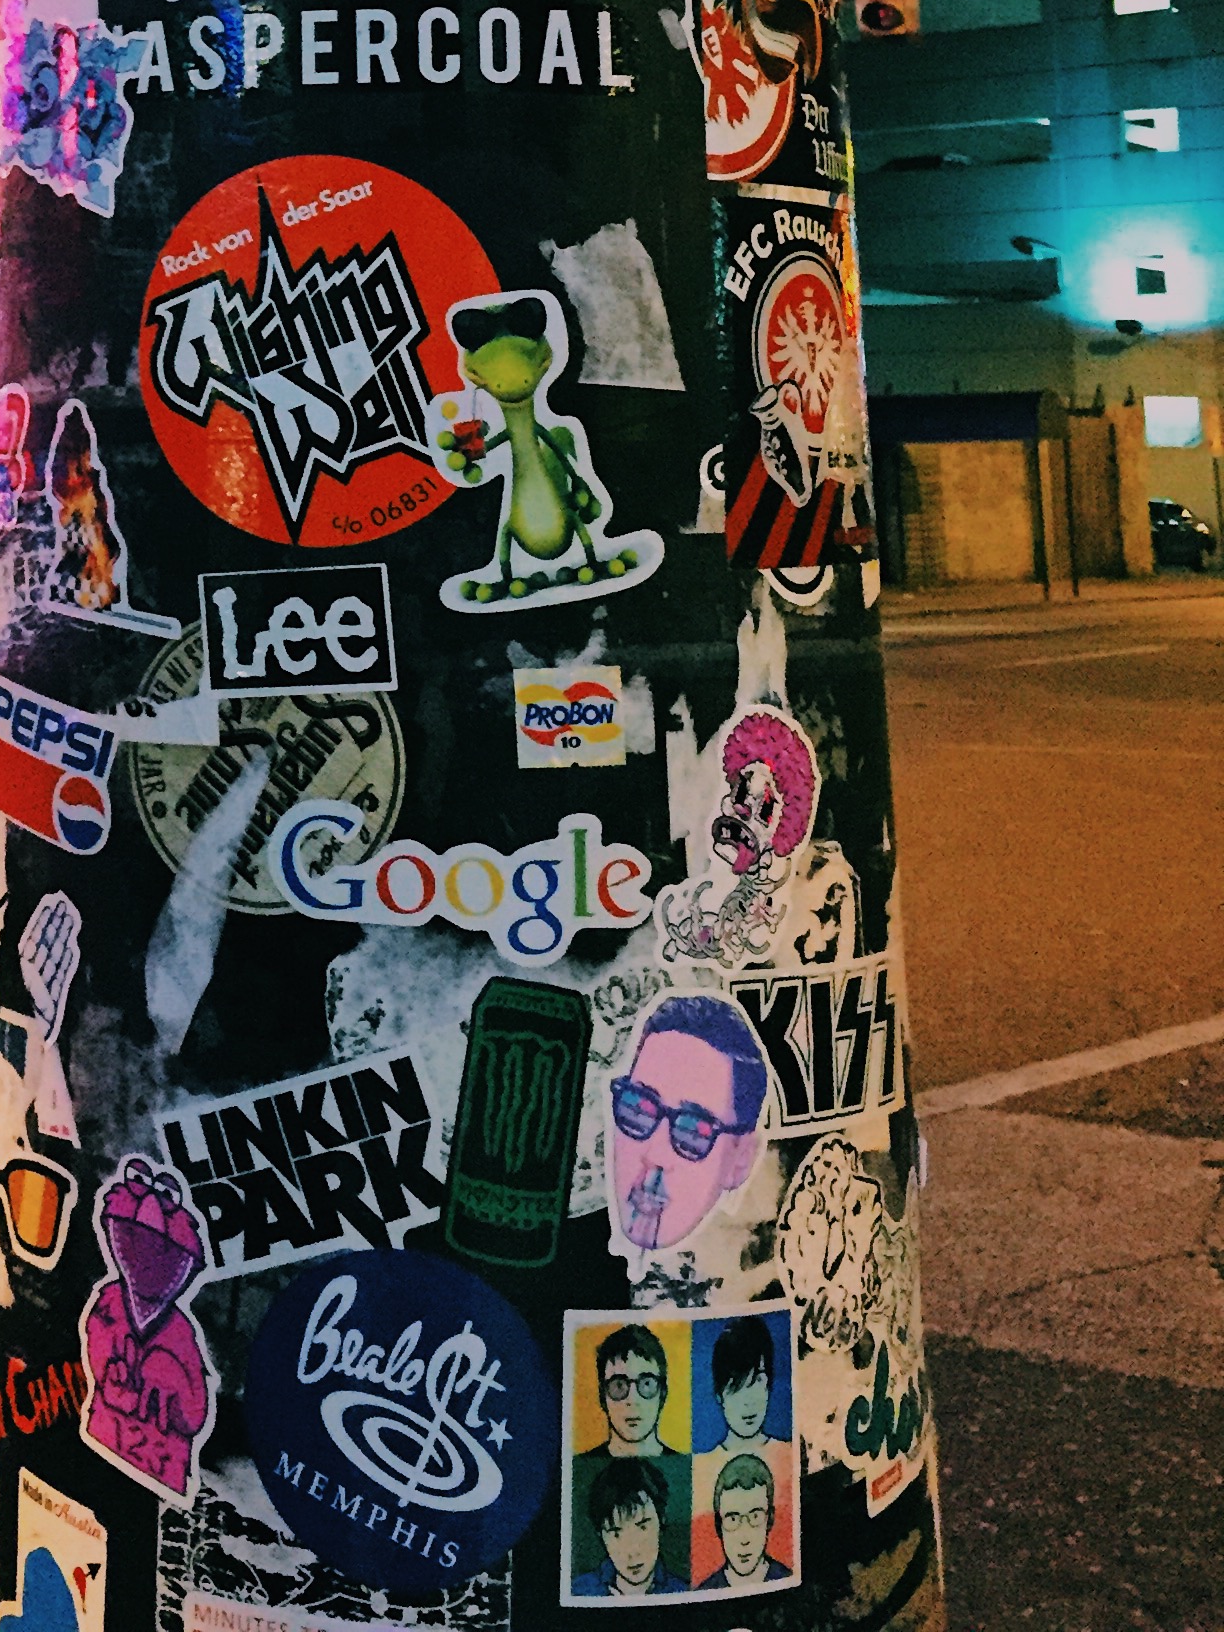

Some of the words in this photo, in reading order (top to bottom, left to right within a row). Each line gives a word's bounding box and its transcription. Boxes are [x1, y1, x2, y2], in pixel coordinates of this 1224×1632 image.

[160, 240, 210, 277] Rock
[212, 228, 254, 256] von
[281, 200, 320, 228] der
[318, 180, 375, 214] Saar
[723, 223, 774, 303] EFC
[772, 208, 843, 268] Rausch
[155, 236, 424, 418] Wishing
[369, 475, 440, 528] 06831
[212, 585, 378, 680] Lee
[524, 701, 615, 728] PROBON
[560, 735, 582, 749] 10
[139, 753, 168, 796] JAR
[280, 814, 642, 956] Google
[730, 966, 897, 1125] KISS
[162, 1054, 430, 1182] LINKIN
[188, 1120, 450, 1270] PARK
[298, 1273, 424, 1397] Beale
[274, 1449, 462, 1569] MEMPHIS
